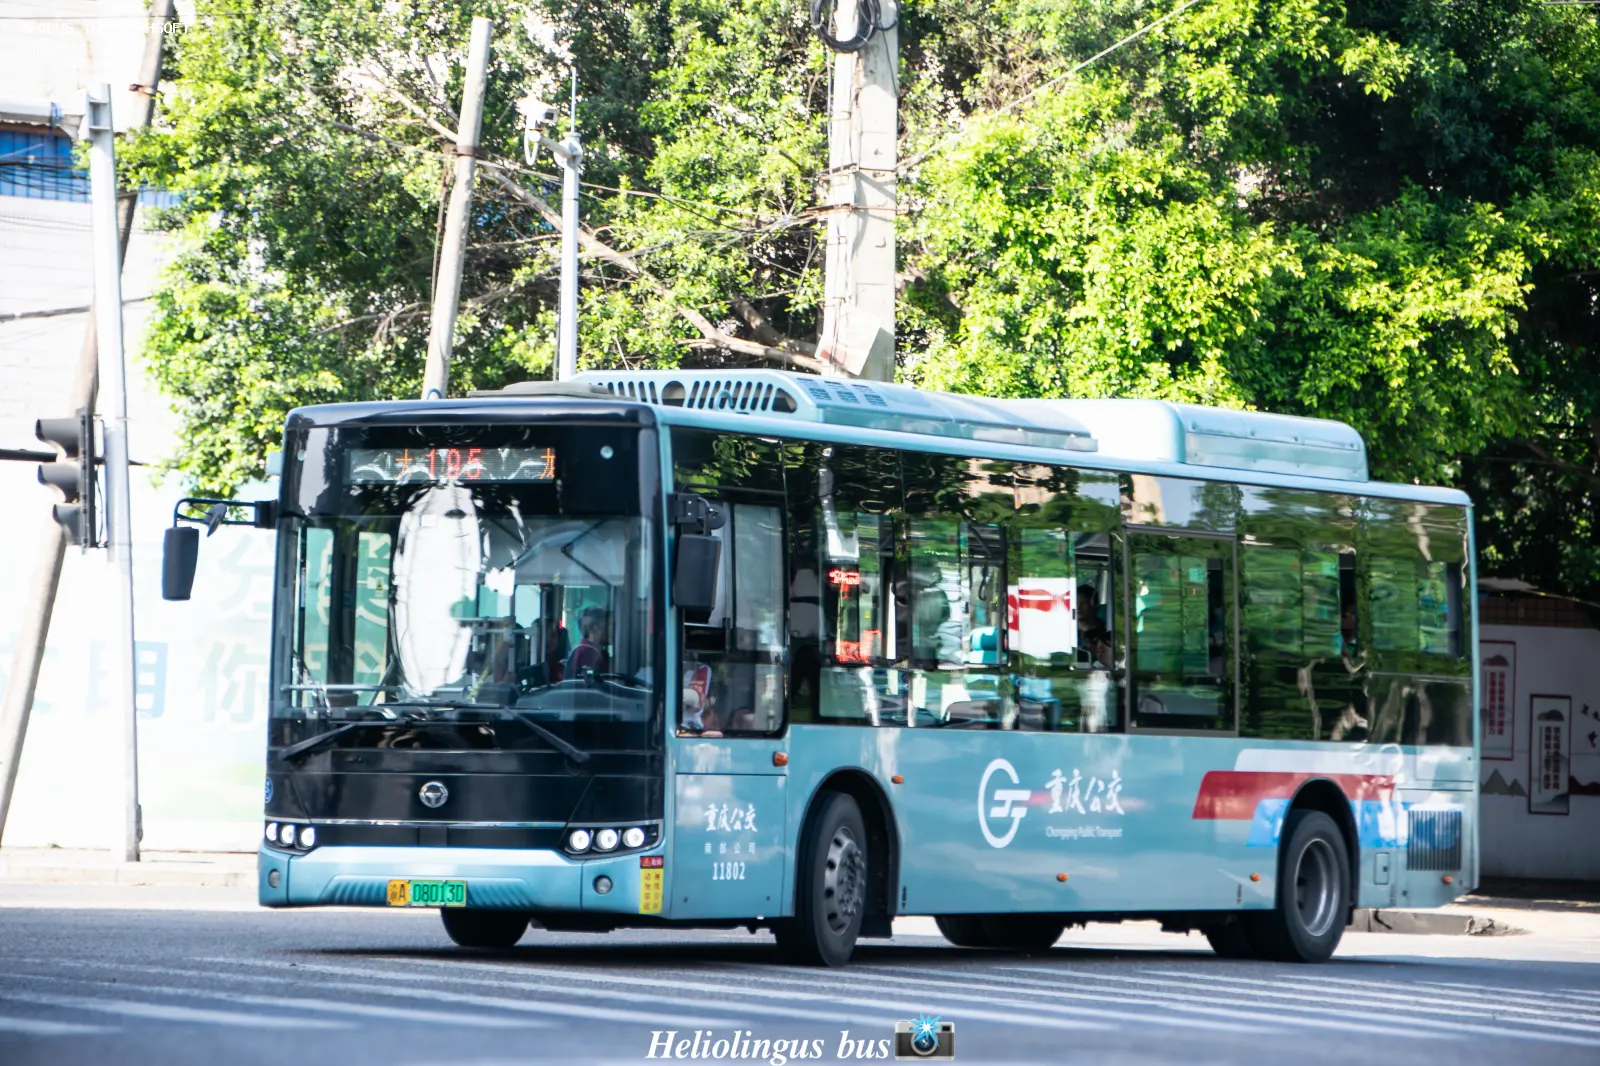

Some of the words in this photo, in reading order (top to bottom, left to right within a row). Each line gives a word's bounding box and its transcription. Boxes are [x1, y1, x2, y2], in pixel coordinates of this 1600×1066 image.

[1044, 768, 1125, 815] 重庆公交
[704, 803, 757, 832] 重庆公交
[712, 862, 746, 880] 11802
